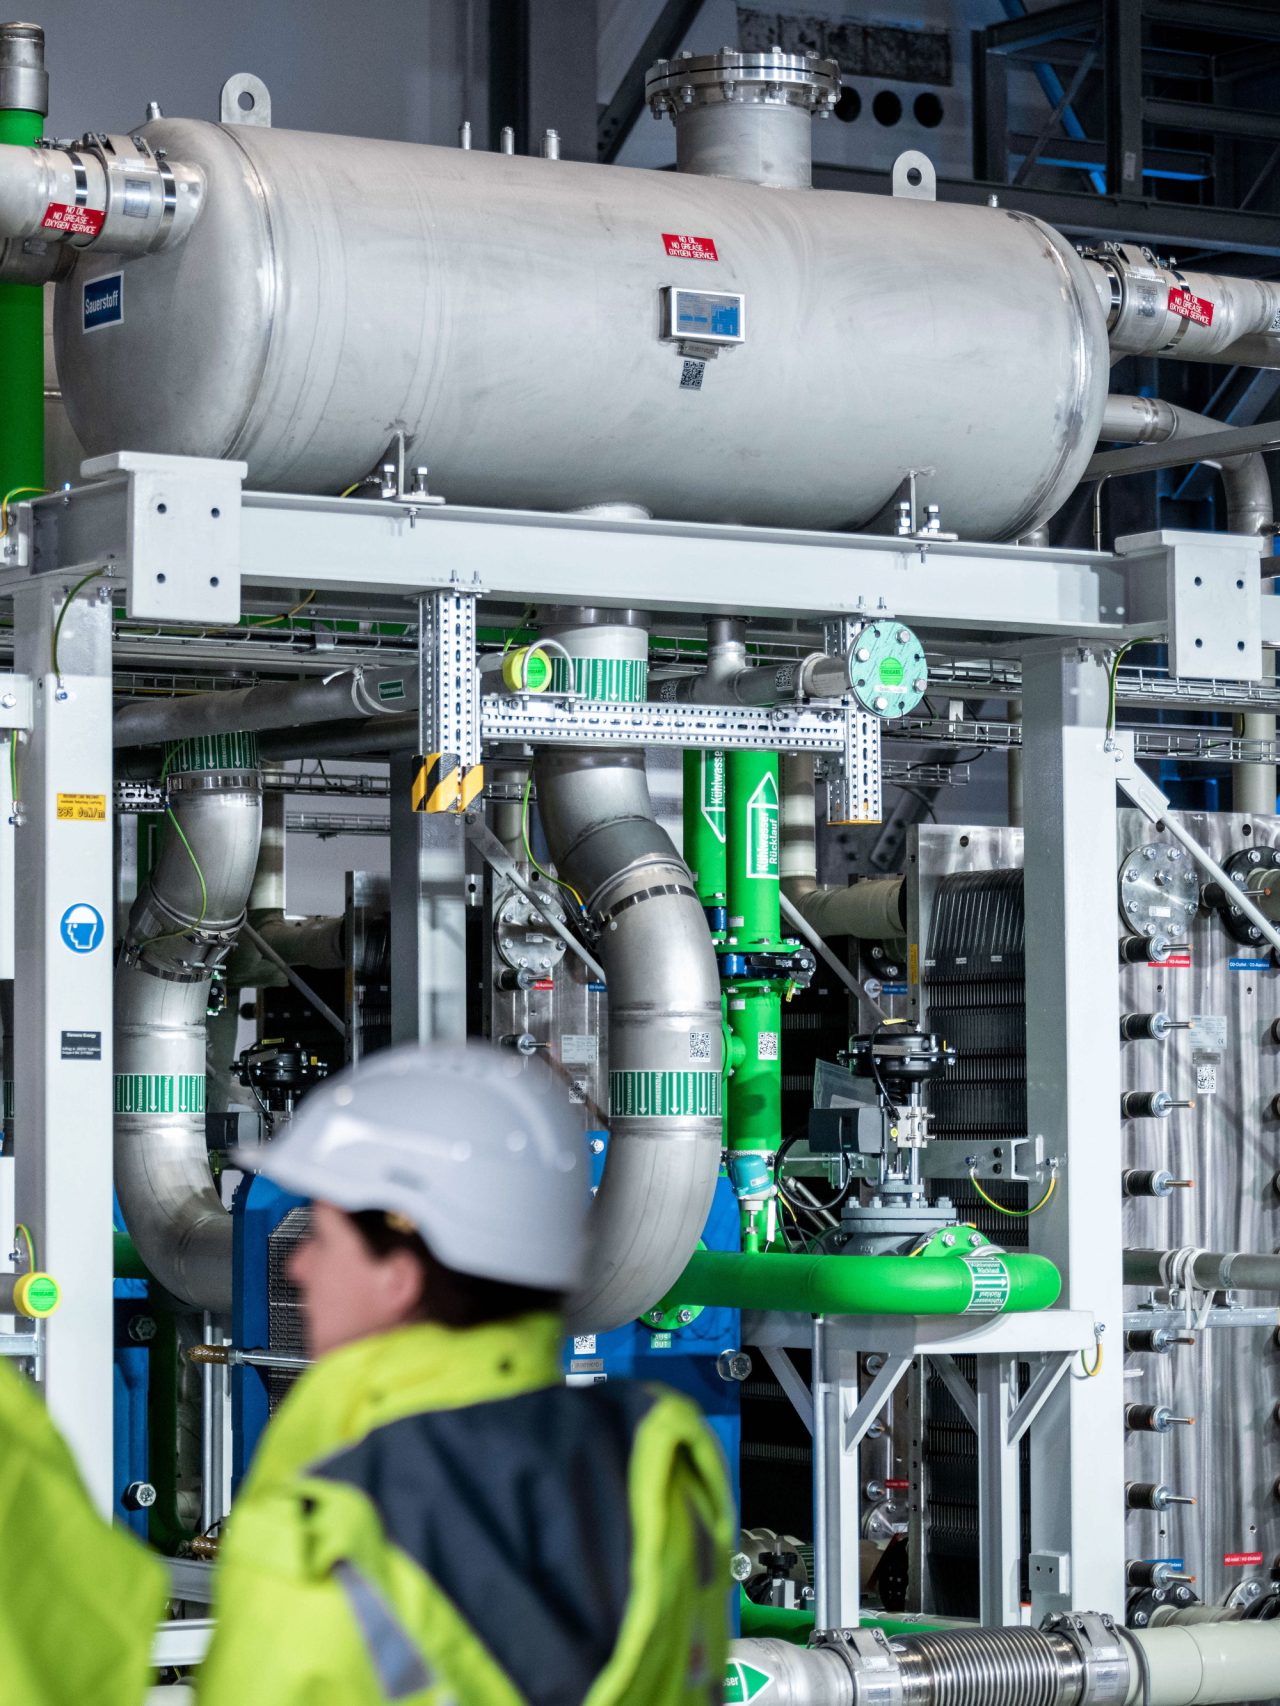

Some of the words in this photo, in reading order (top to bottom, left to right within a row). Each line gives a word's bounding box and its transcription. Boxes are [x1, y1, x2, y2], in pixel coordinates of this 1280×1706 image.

[52, 212, 63, 220] NO
[63, 213, 89, 225] GREASE
[65, 206, 75, 214] NO
[44, 218, 70, 230] OXYGEN
[70, 223, 97, 235] SERVICE
[669, 248, 692, 258] OXYGEN
[692, 250, 716, 260] SERVICE
[681, 242, 703, 252] GREASE
[85, 290, 119, 315] Sauerstoff
[1174, 297, 1182, 306] NO
[1182, 300, 1202, 314] GREASE
[1183, 292, 1191, 301] NO
[1169, 302, 1189, 317] OXYGEN
[1189, 309, 1210, 325] SERVICE
[711, 750, 723, 804] Kühlwasse
[756, 812, 769, 872] Kühlwasser
[769, 818, 778, 865] Rücklauf
[655, 1072, 663, 1115] Prozesswasser
[685, 1073, 694, 1115] Prozesswasser
